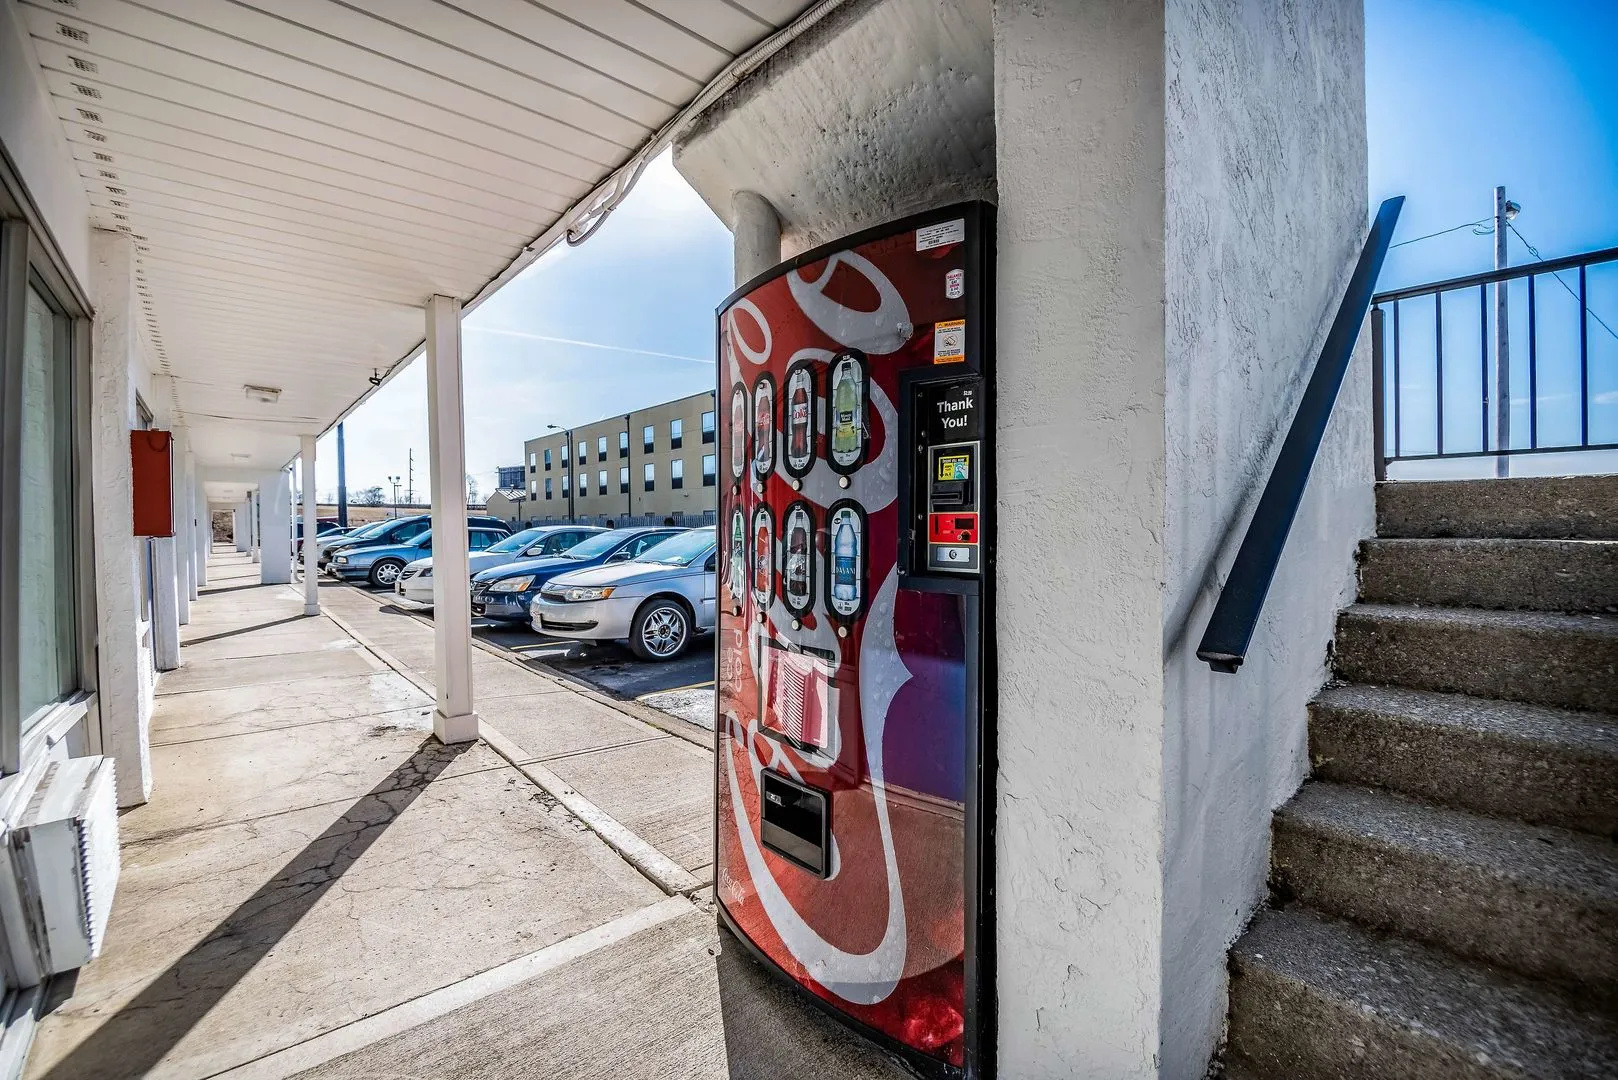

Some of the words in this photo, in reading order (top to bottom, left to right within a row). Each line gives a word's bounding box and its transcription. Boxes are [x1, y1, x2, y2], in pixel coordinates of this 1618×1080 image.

[937, 397, 973, 413] Thank
[941, 415, 968, 428] You!
[733, 628, 743, 693] cold
